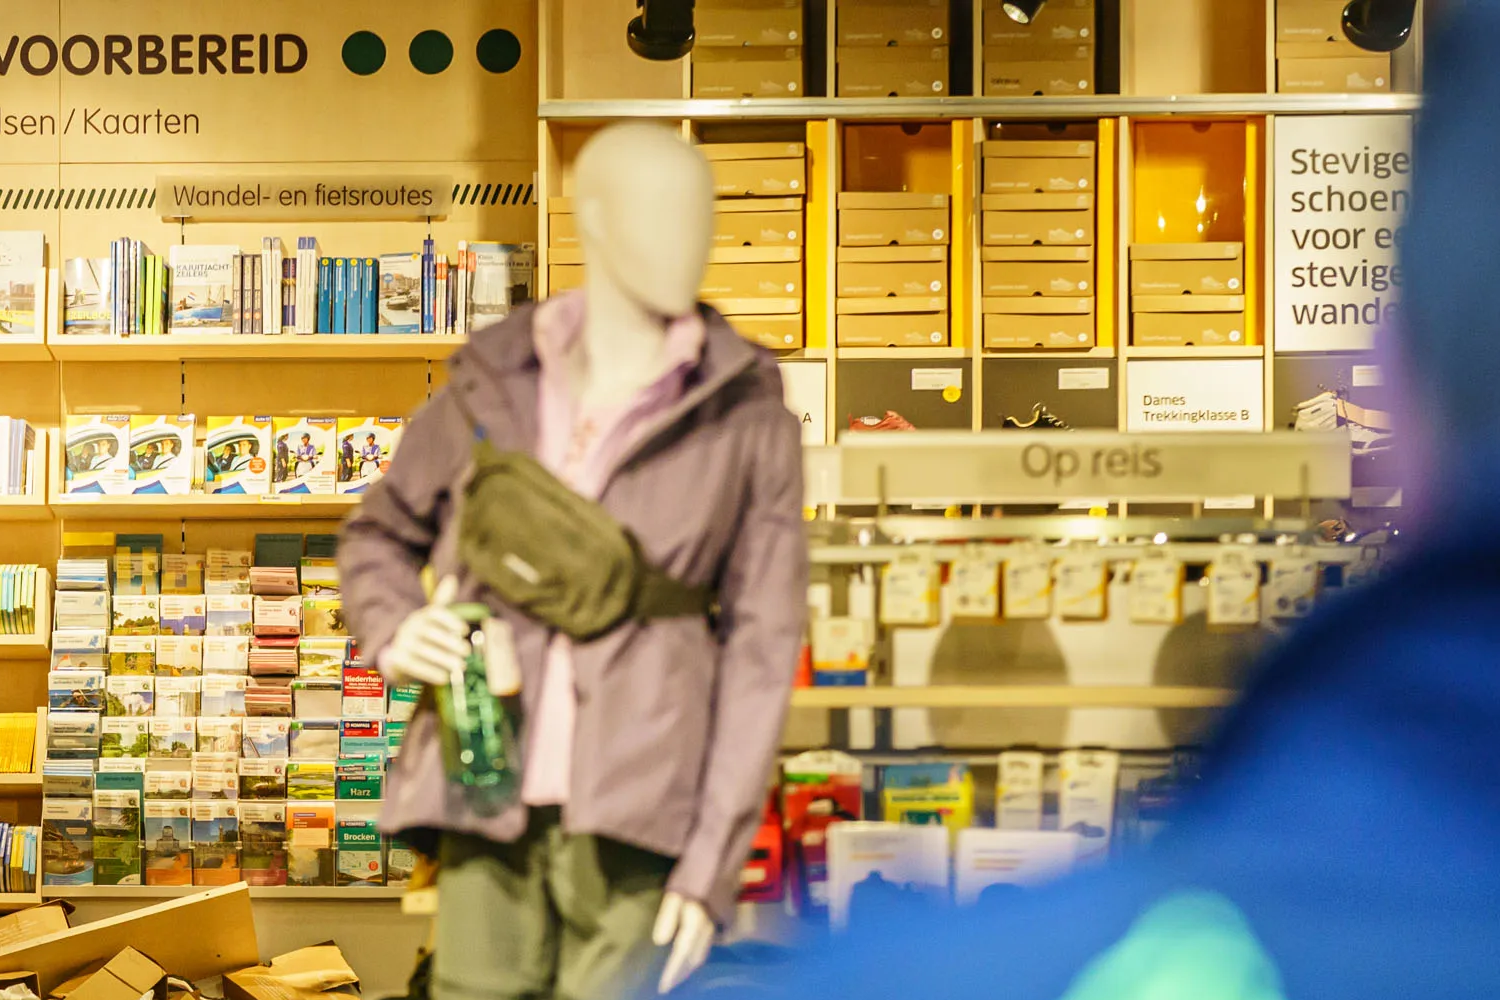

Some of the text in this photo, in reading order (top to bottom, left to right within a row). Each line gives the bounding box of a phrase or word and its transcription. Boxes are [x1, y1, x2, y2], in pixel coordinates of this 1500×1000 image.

[83, 108, 200, 135] Kaarten
[1291, 146, 1411, 179] Stevige
[173, 184, 433, 206] Wandel- en fietsroutes
[1292, 227, 1365, 250] voor
[1292, 259, 1406, 292] stevige
[1143, 395, 1186, 406] Dames
[1143, 409, 1249, 423] Trekkingklasse B
[1020, 443, 1163, 483] Op reis
[344, 675, 383, 683] Niederrhein
[350, 787, 371, 796] Harz
[343, 833, 376, 841] Brocken
